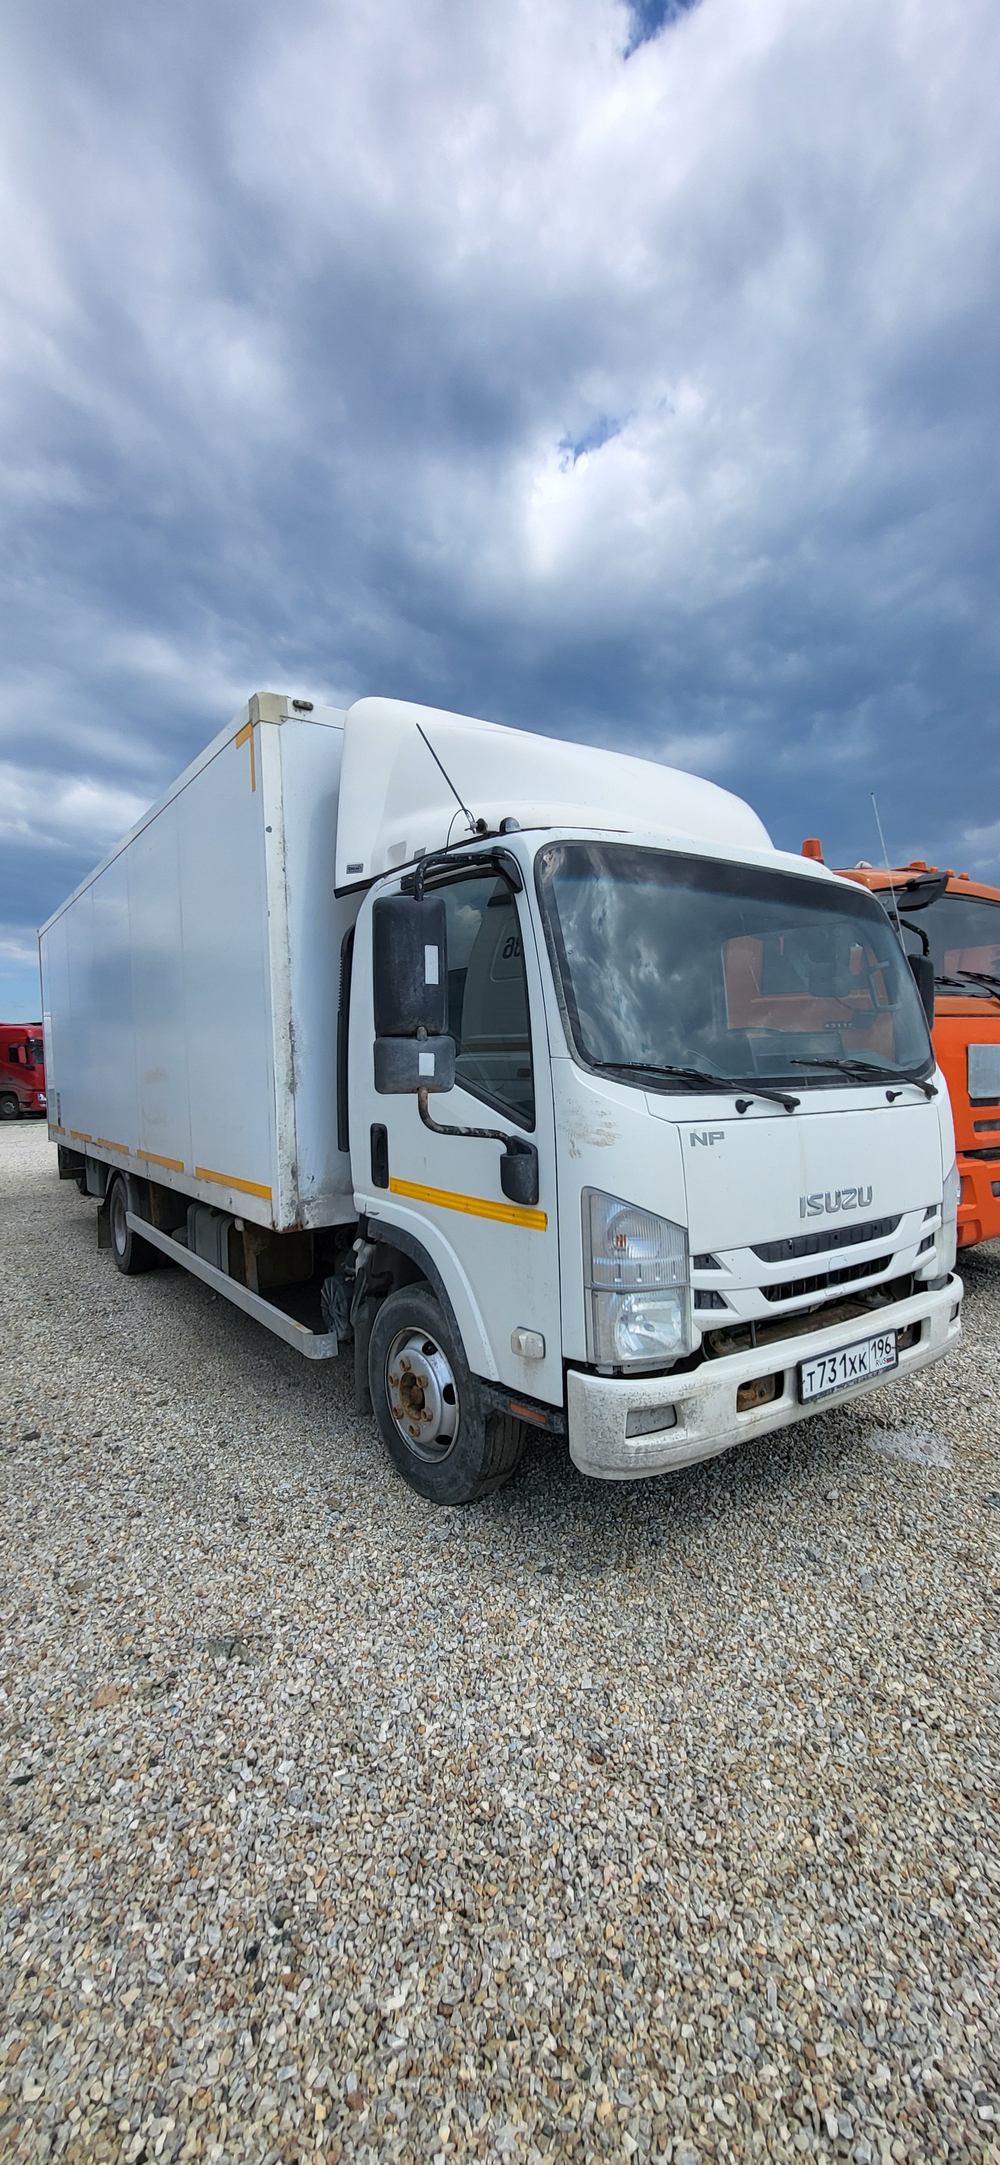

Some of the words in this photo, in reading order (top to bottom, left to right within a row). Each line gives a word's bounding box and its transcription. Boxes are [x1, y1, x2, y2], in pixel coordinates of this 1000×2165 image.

[690, 1131, 725, 1147] NP
[799, 1185, 873, 1219] ISUZU
[870, 1336, 892, 1360] 196
[875, 1356, 887, 1367] RUS
